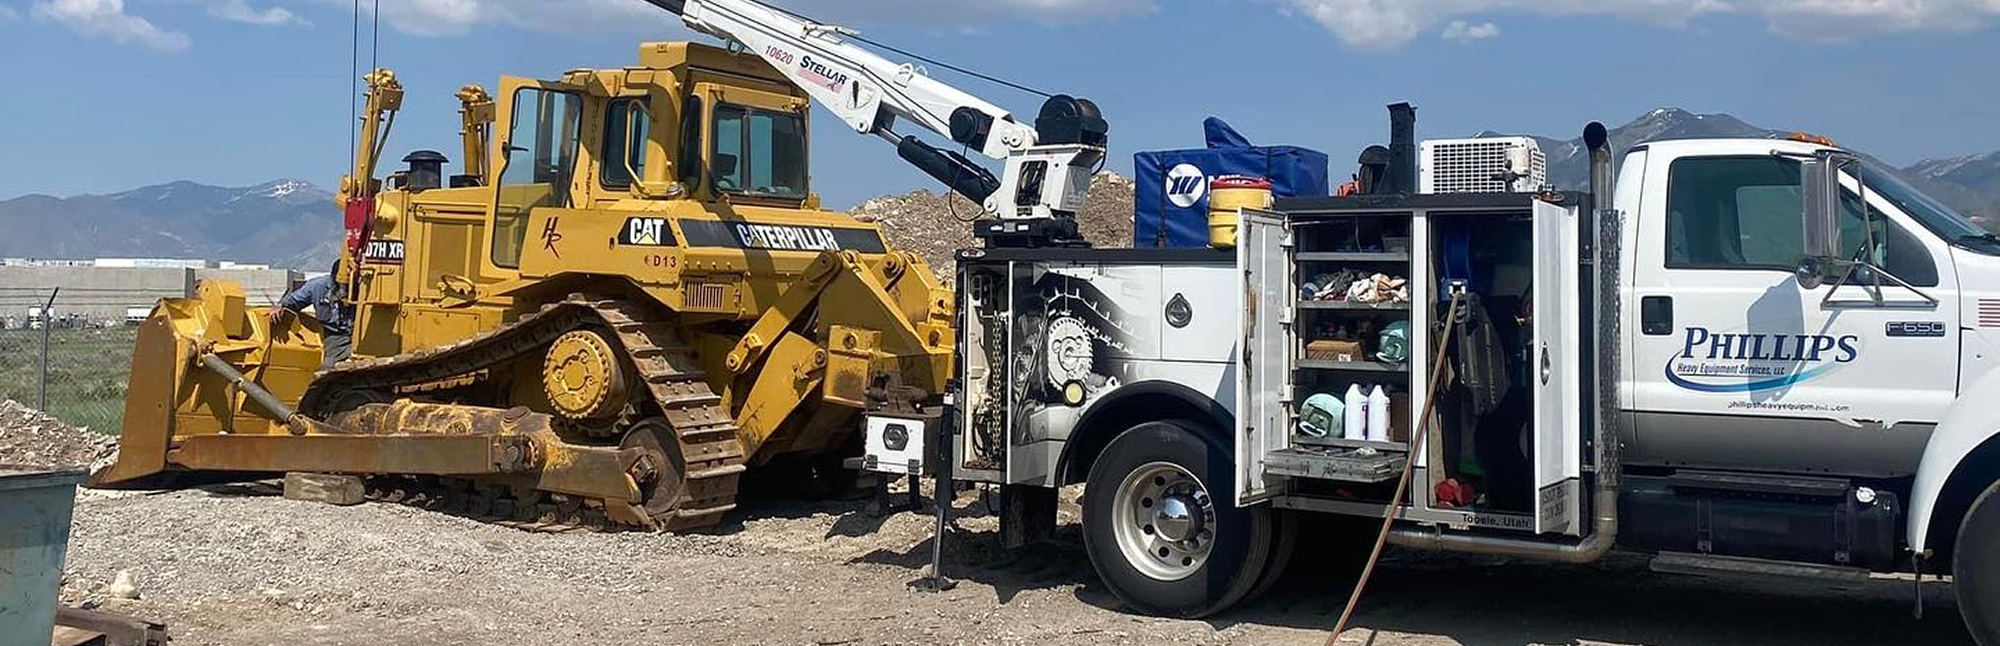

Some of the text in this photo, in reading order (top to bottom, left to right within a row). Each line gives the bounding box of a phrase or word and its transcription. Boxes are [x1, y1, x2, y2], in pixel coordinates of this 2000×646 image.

[765, 45, 794, 65] 10620
[800, 55, 847, 85] STELLAR
[630, 217, 664, 244] CAT
[736, 223, 840, 250] CATERPILLAR
[389, 242, 404, 258] XR
[1681, 327, 1858, 363] PHILLIPS
[1677, 363, 1698, 374] Heavy
[1700, 363, 1738, 374] Equipment
